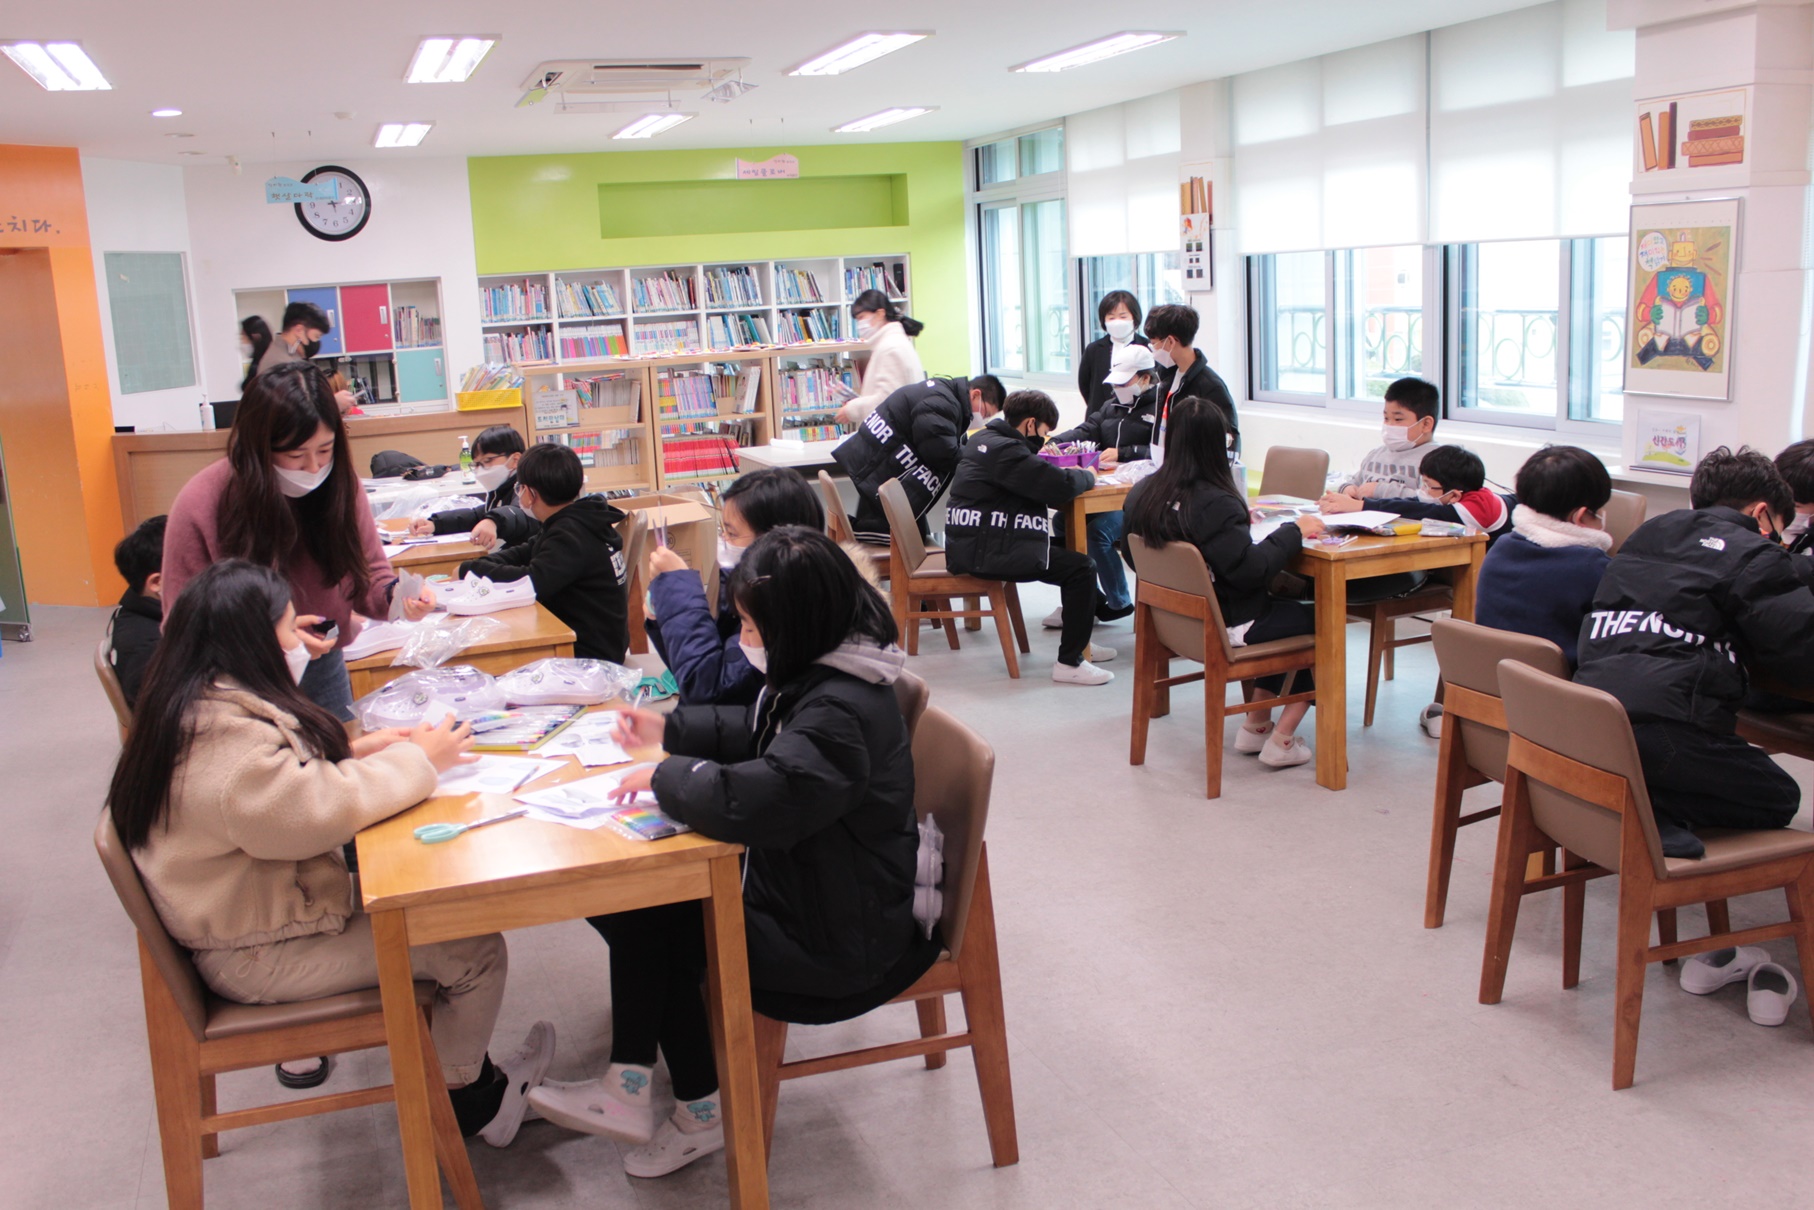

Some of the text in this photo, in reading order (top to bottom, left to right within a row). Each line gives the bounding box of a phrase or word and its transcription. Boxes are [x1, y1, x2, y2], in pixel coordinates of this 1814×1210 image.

[0, 215, 60, 235] 치다.
[1014, 514, 1049, 533] FACE
[1590, 611, 1644, 640] THE
